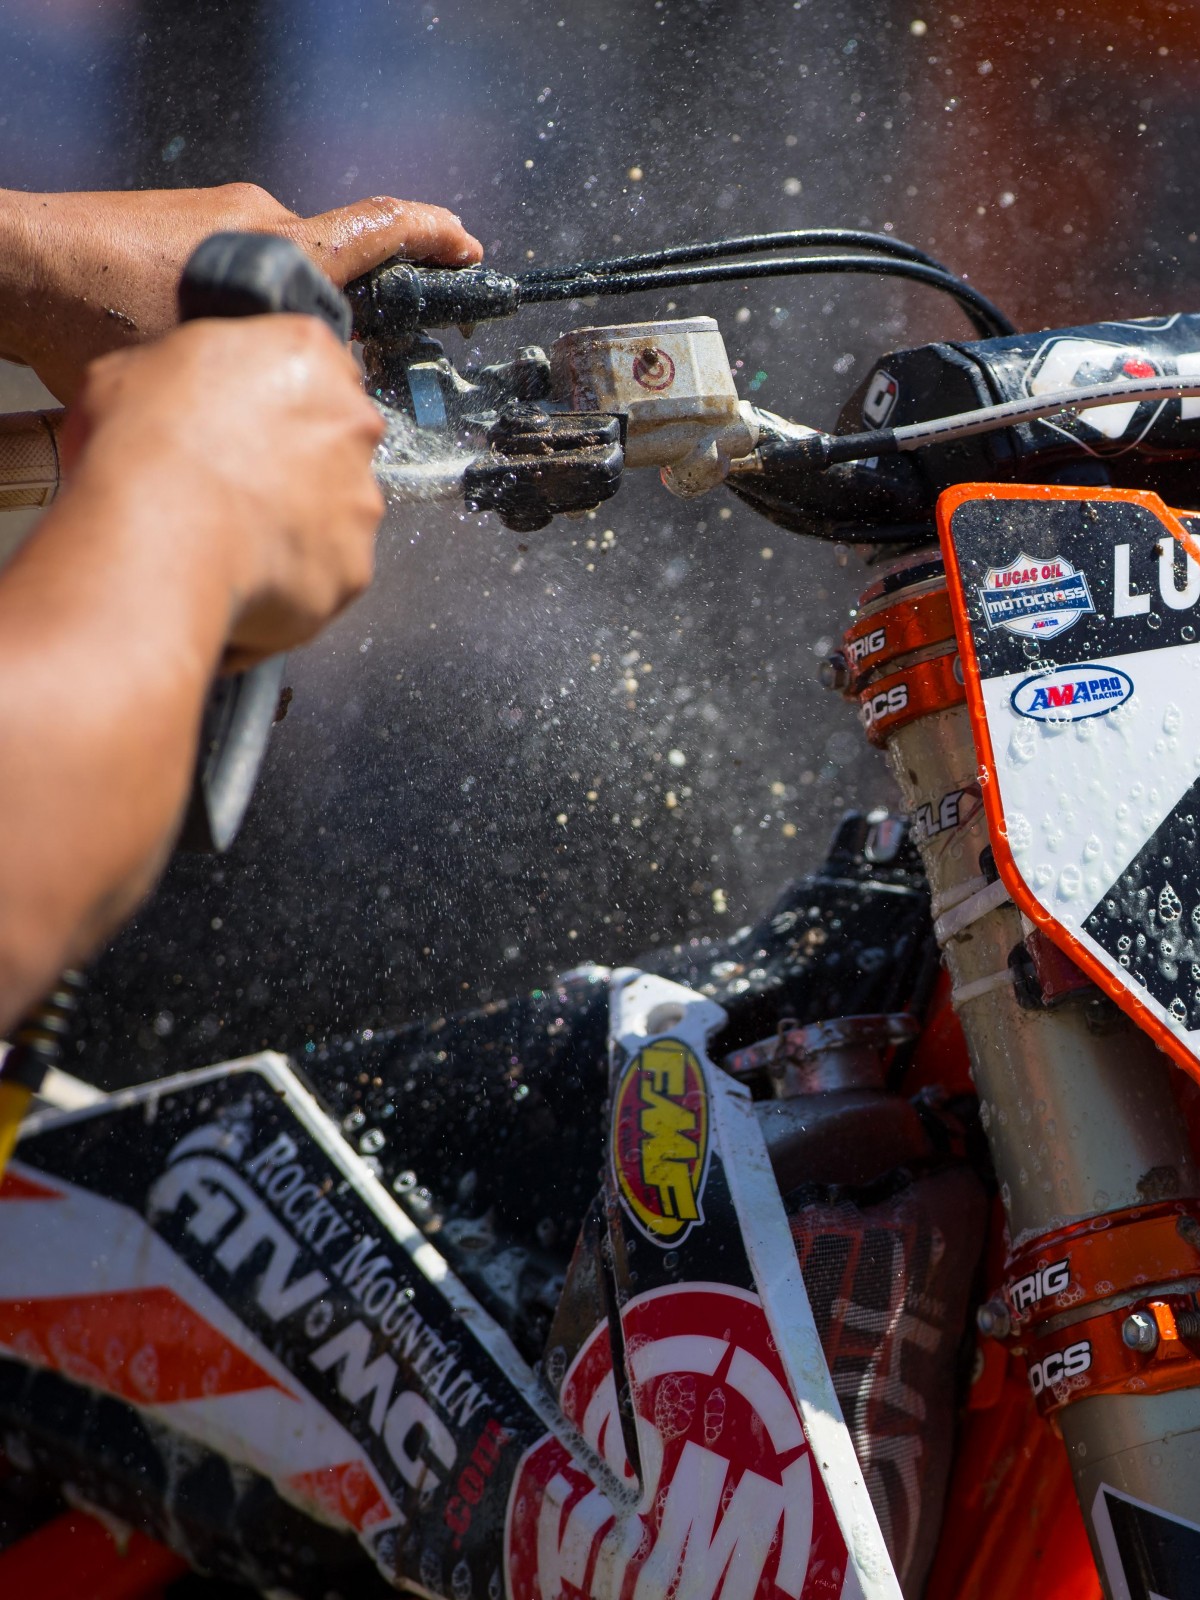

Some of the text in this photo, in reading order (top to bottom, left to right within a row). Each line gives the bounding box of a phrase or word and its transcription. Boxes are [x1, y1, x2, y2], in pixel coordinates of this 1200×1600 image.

[995, 564, 1064, 588] LUCAS OIL
[987, 586, 1086, 613] MOTOCROSS
[1026, 676, 1122, 712] AMA PRO
[1092, 690, 1124, 701] RACING
[636, 1047, 701, 1222] FMF
